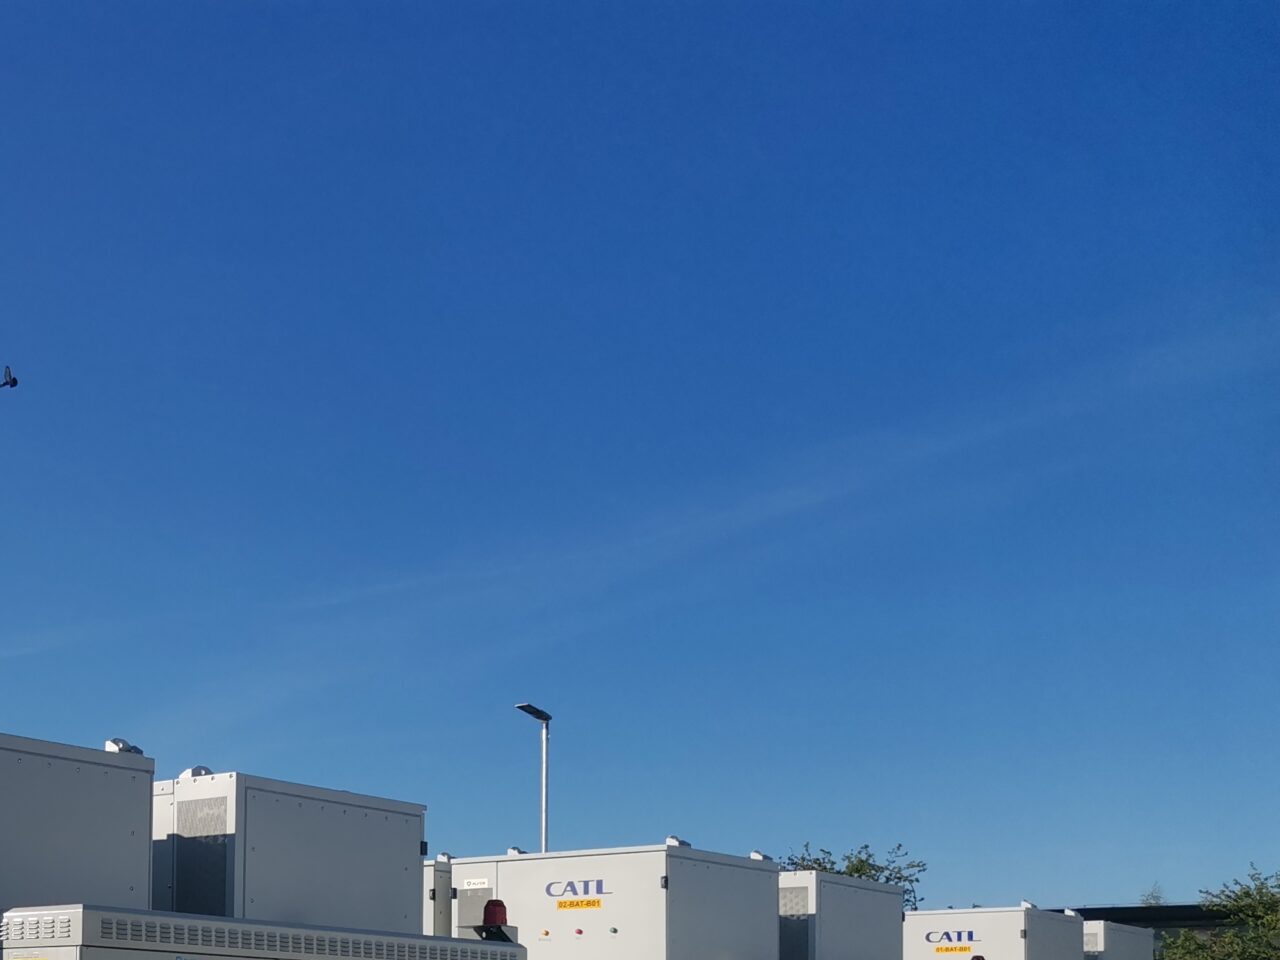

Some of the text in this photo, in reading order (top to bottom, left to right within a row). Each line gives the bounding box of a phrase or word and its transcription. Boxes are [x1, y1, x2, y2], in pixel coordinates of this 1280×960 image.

[545, 879, 614, 897] CATL
[558, 899, 601, 909] 02-BAT-B01
[925, 930, 982, 943] CATL
